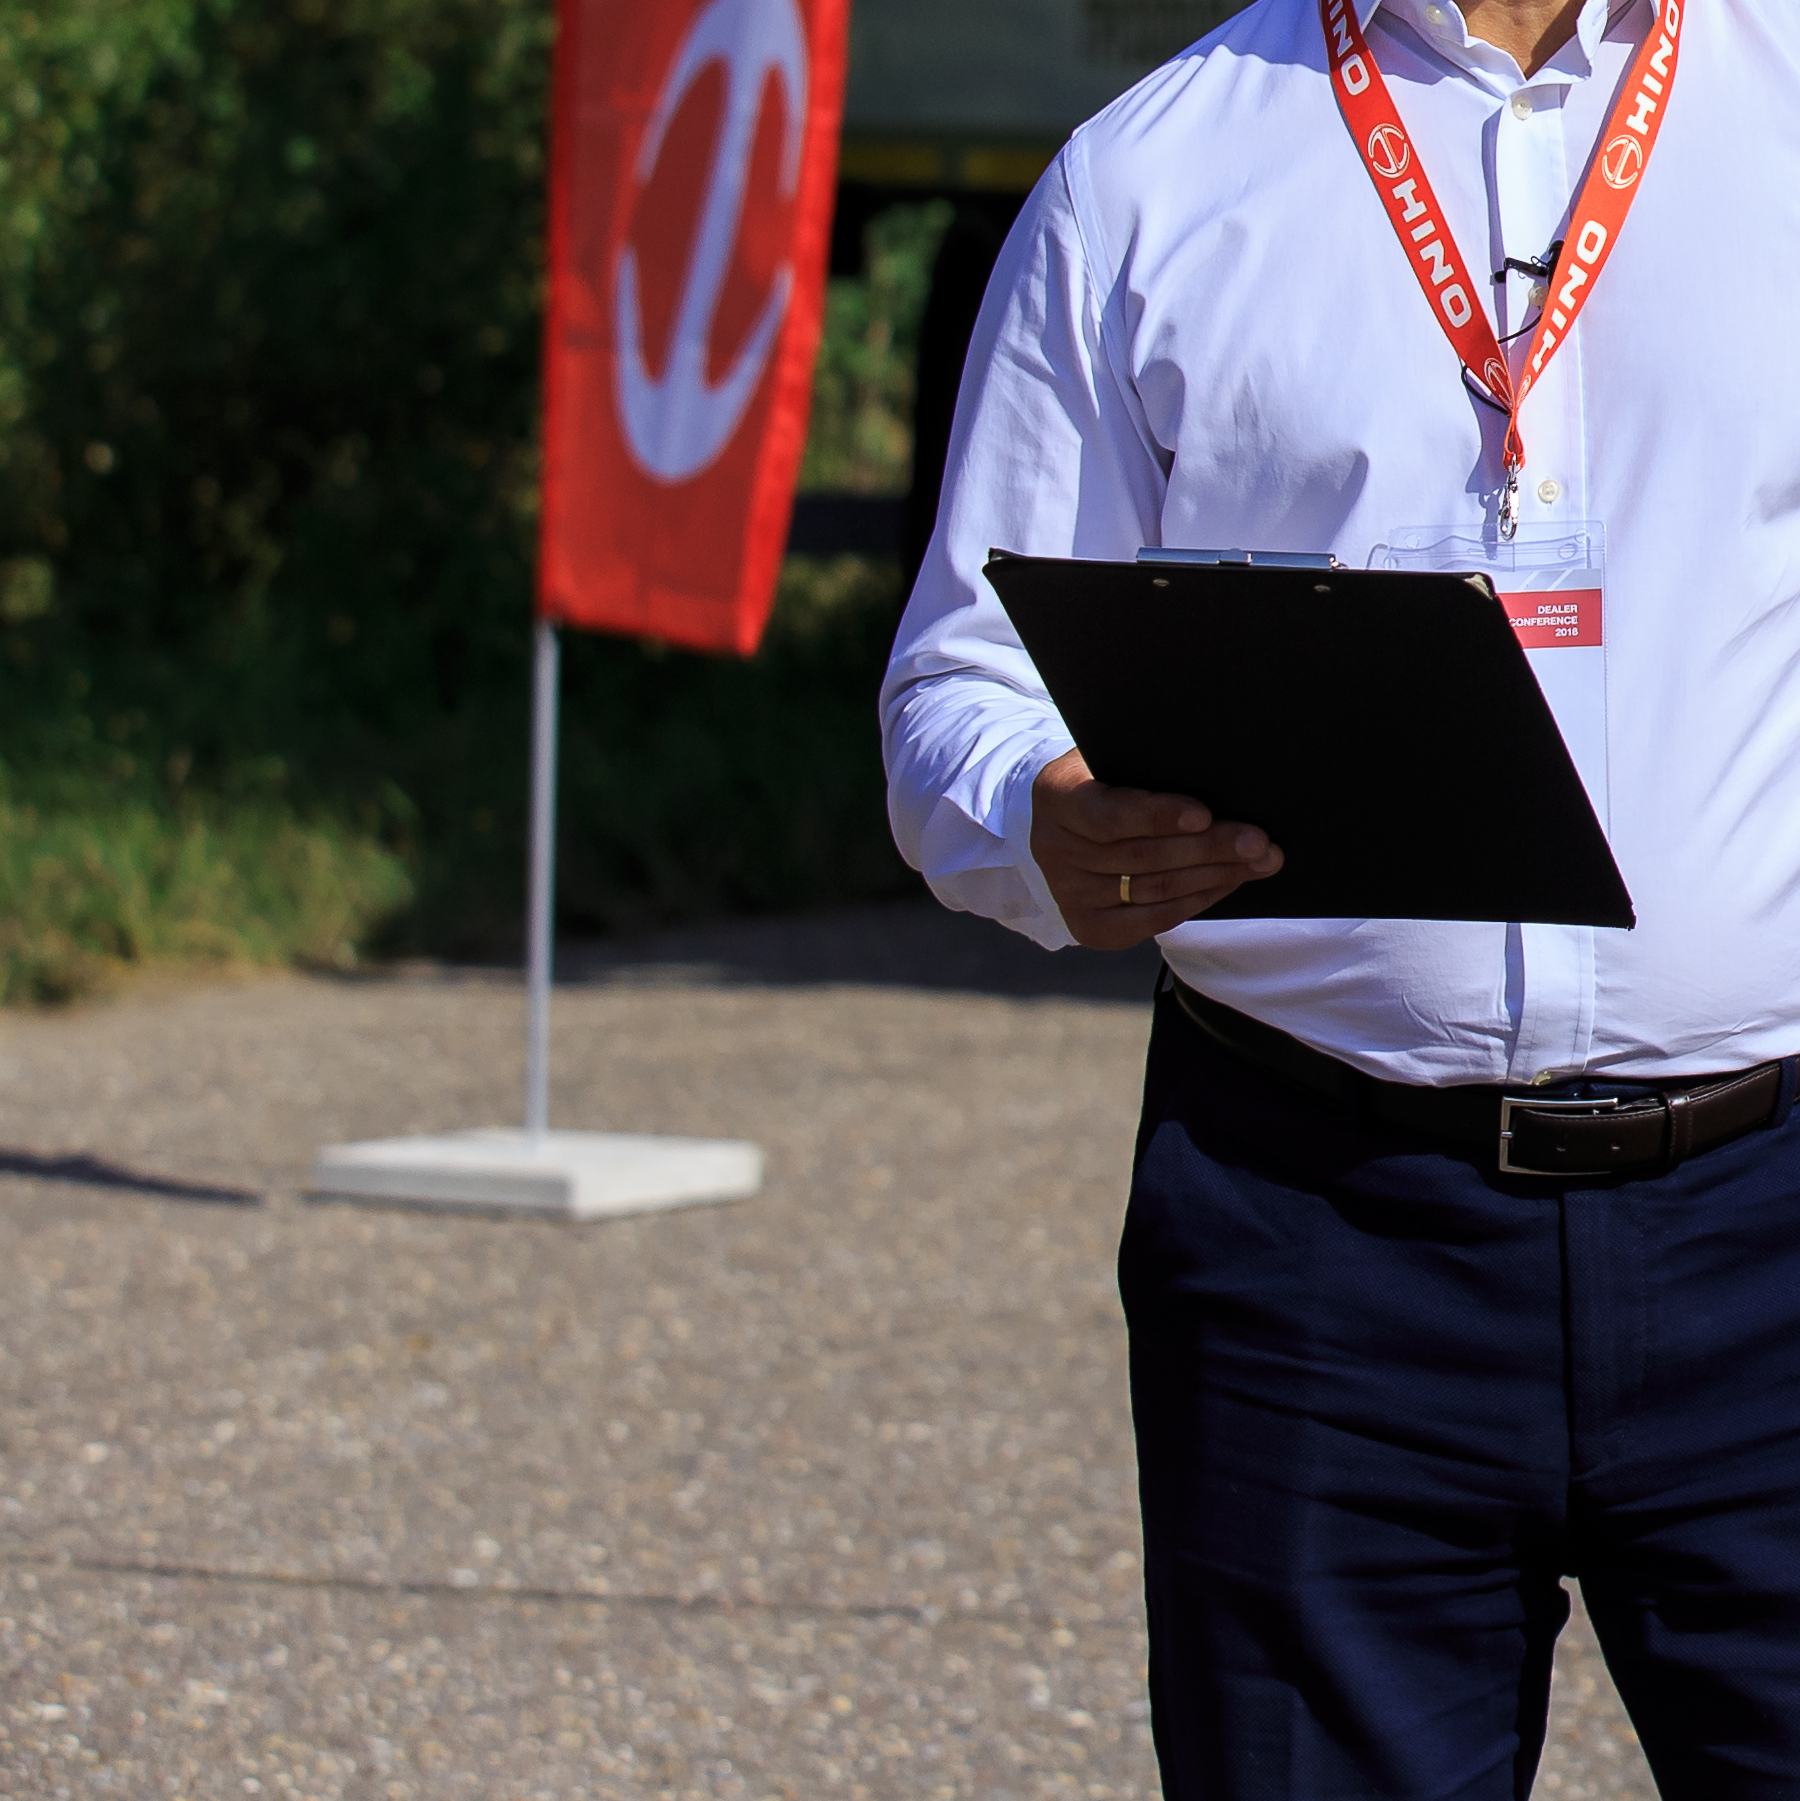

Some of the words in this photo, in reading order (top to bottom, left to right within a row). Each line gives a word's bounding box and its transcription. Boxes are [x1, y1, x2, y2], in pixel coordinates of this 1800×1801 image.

[1626, 1, 1679, 136] HINO
[1391, 178, 1472, 329] HINO
[1532, 221, 1607, 374] HINO
[1509, 616, 1578, 627] CONFERENCE
[1537, 604, 1578, 615] DEALER
[1555, 627, 1578, 637] 2018
